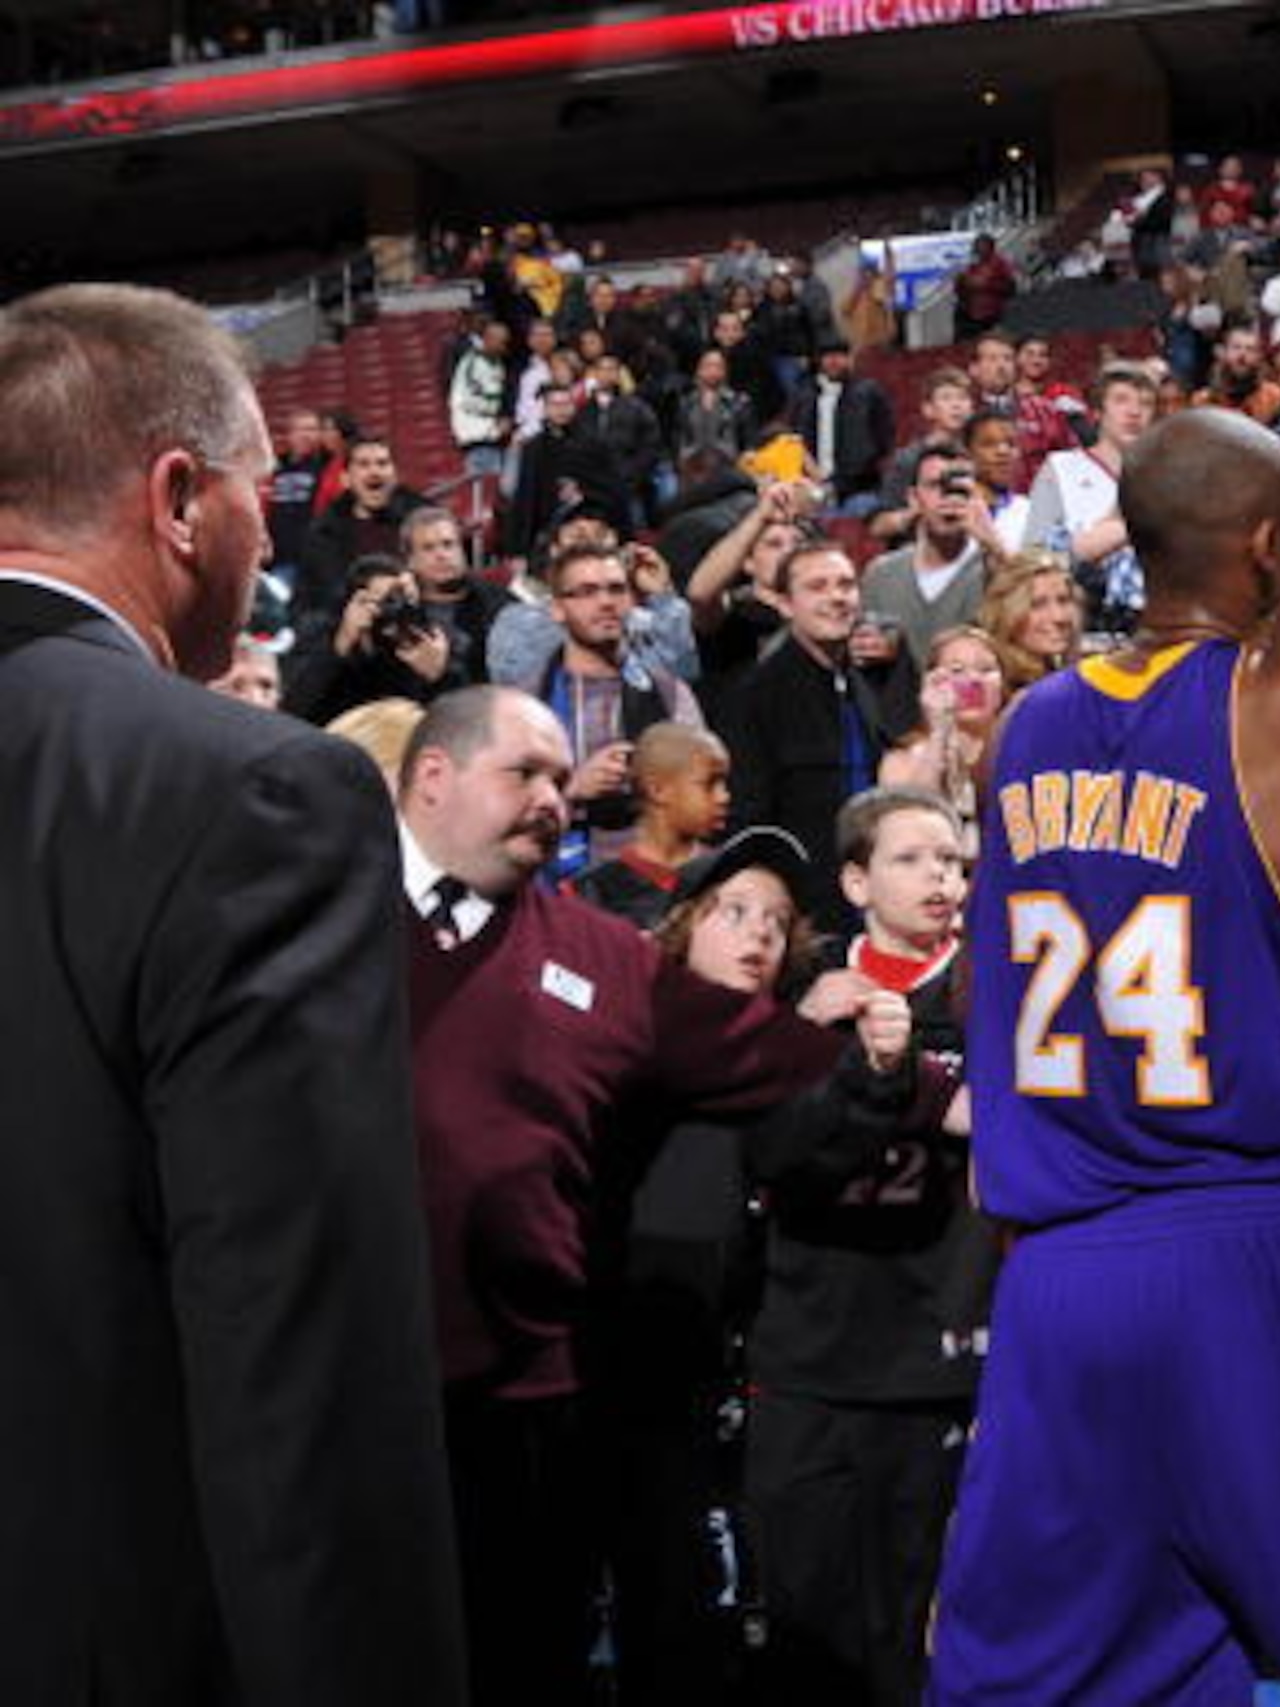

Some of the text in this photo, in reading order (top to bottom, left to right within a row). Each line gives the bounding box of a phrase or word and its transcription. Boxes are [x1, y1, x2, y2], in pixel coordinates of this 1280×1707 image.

[730, 10, 779, 48] VS
[999, 769, 1208, 869] BRYANT
[1007, 889, 1214, 1107] 24
